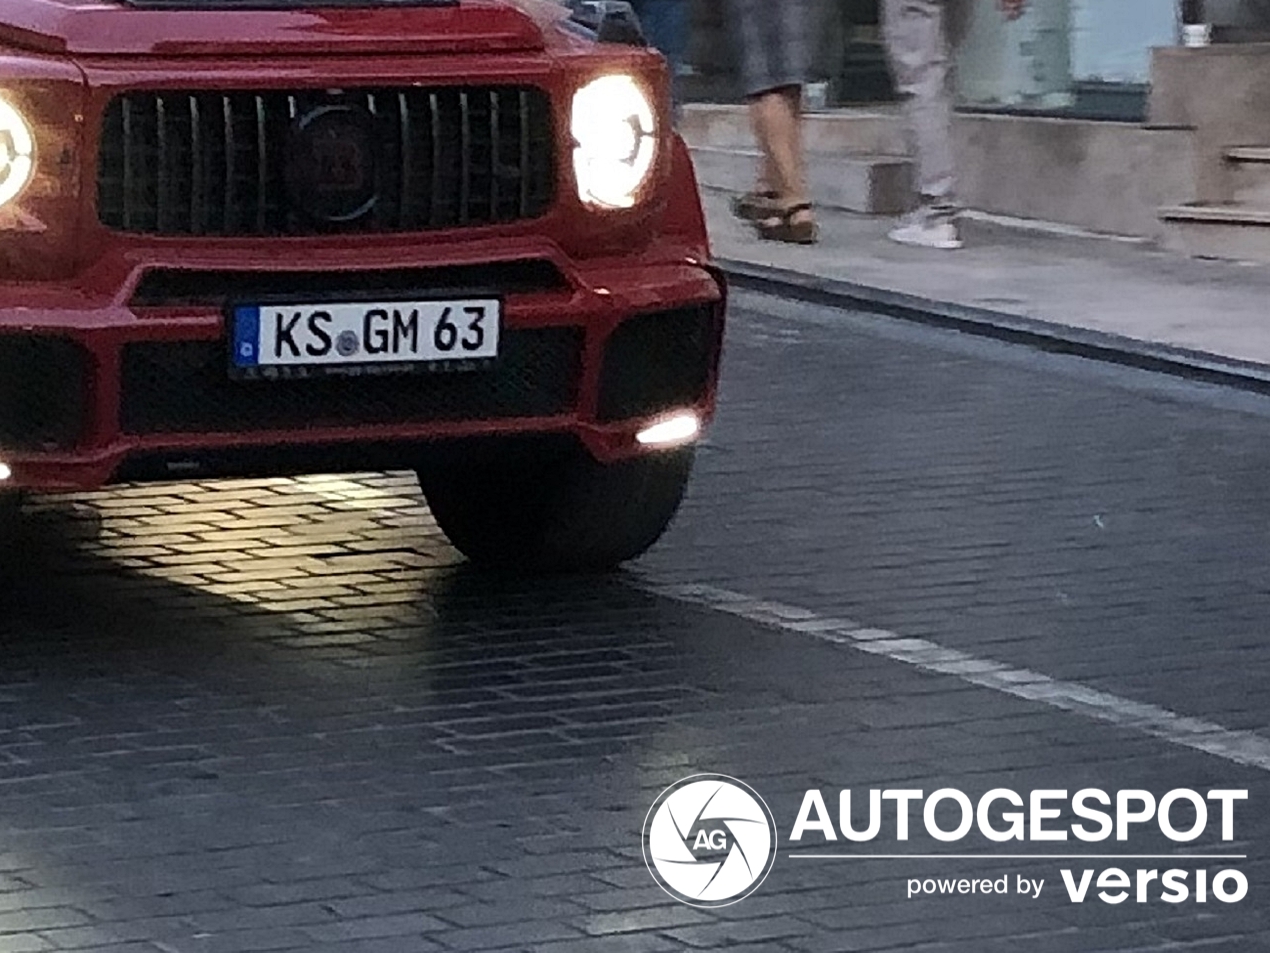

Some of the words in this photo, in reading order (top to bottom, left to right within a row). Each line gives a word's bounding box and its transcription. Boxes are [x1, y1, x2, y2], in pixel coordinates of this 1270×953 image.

[274, 310, 332, 358] KS
[362, 308, 419, 355] GM
[433, 306, 485, 352] 63
